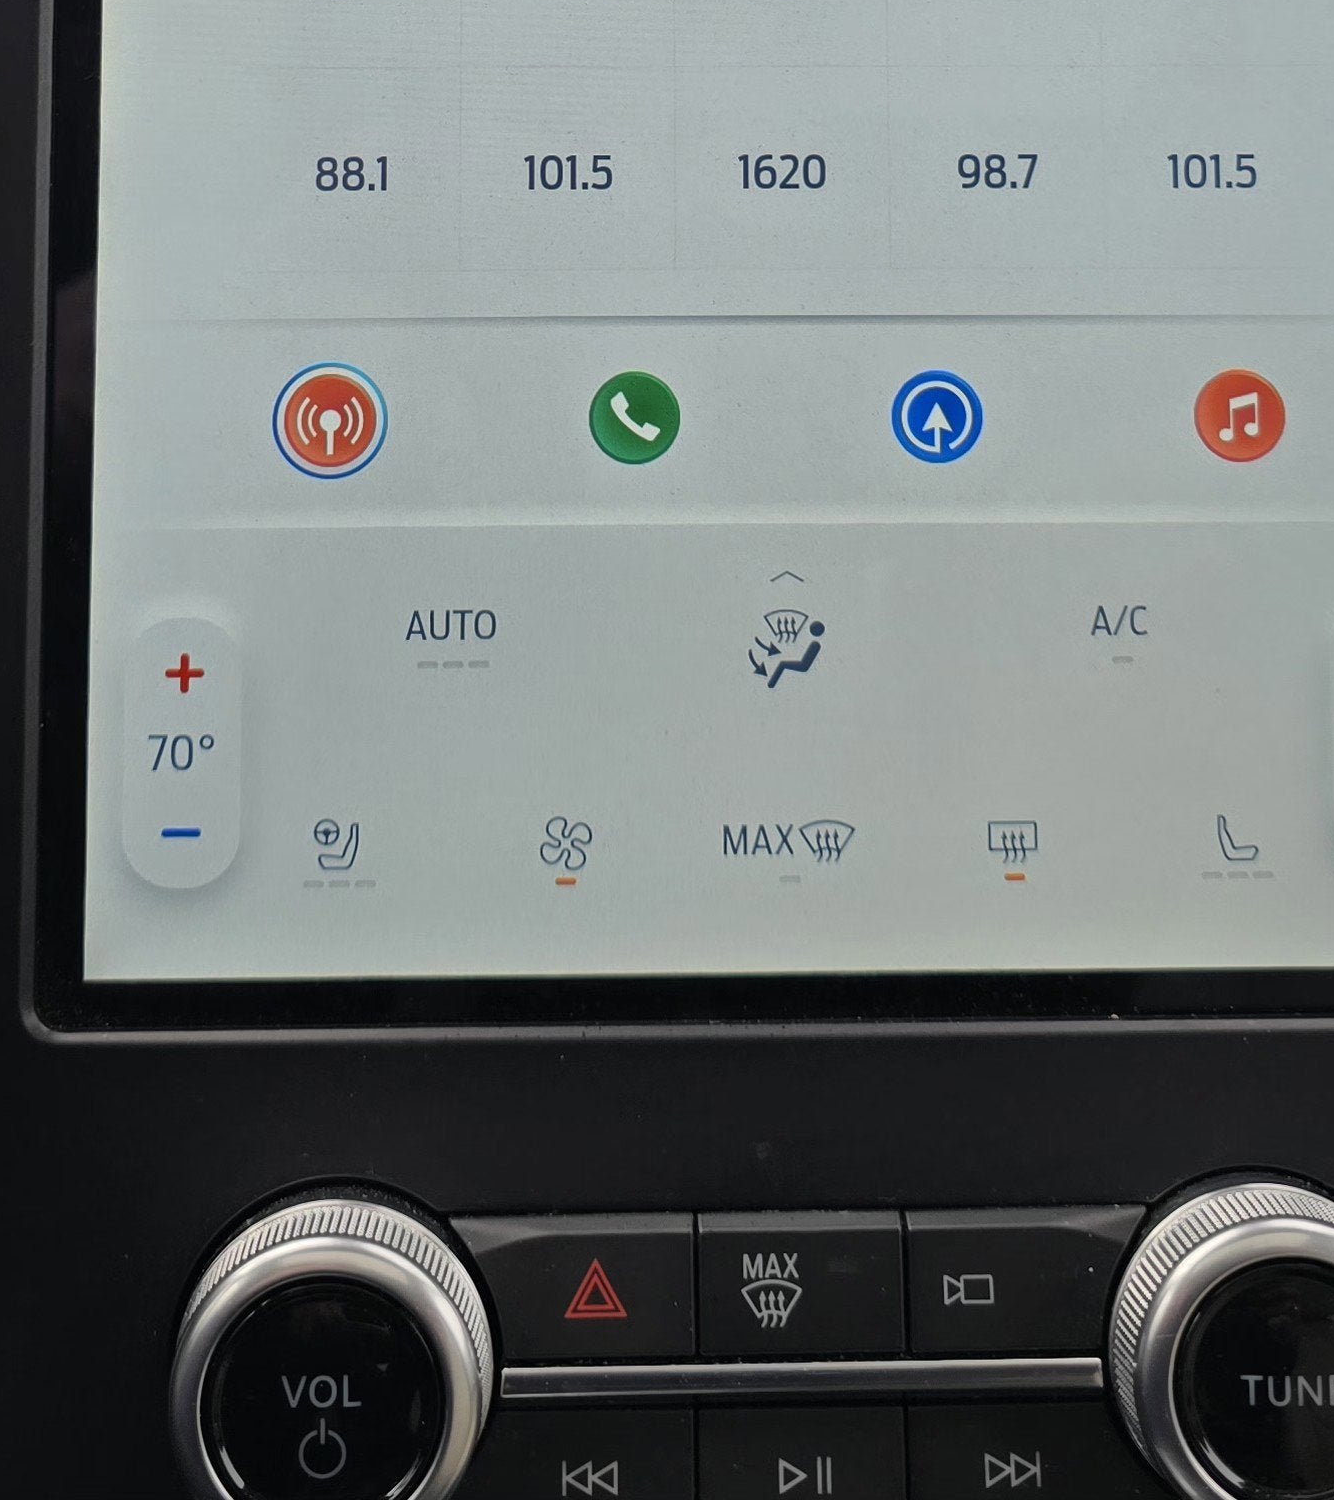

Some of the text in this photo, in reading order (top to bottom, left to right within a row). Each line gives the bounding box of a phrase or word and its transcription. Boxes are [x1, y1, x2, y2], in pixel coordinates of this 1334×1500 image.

[315, 155, 388, 192] 88.1
[523, 154, 613, 191] 101.5
[737, 153, 827, 190] 1620
[957, 153, 1038, 189] 98.7
[1166, 153, 1257, 189] 101.5
[405, 609, 497, 641] AUTO
[1090, 605, 1148, 637] A/C
[148, 734, 215, 772] 70°
[723, 823, 794, 856] MAX
[742, 1252, 800, 1281] MAX
[281, 1374, 362, 1409] VOL
